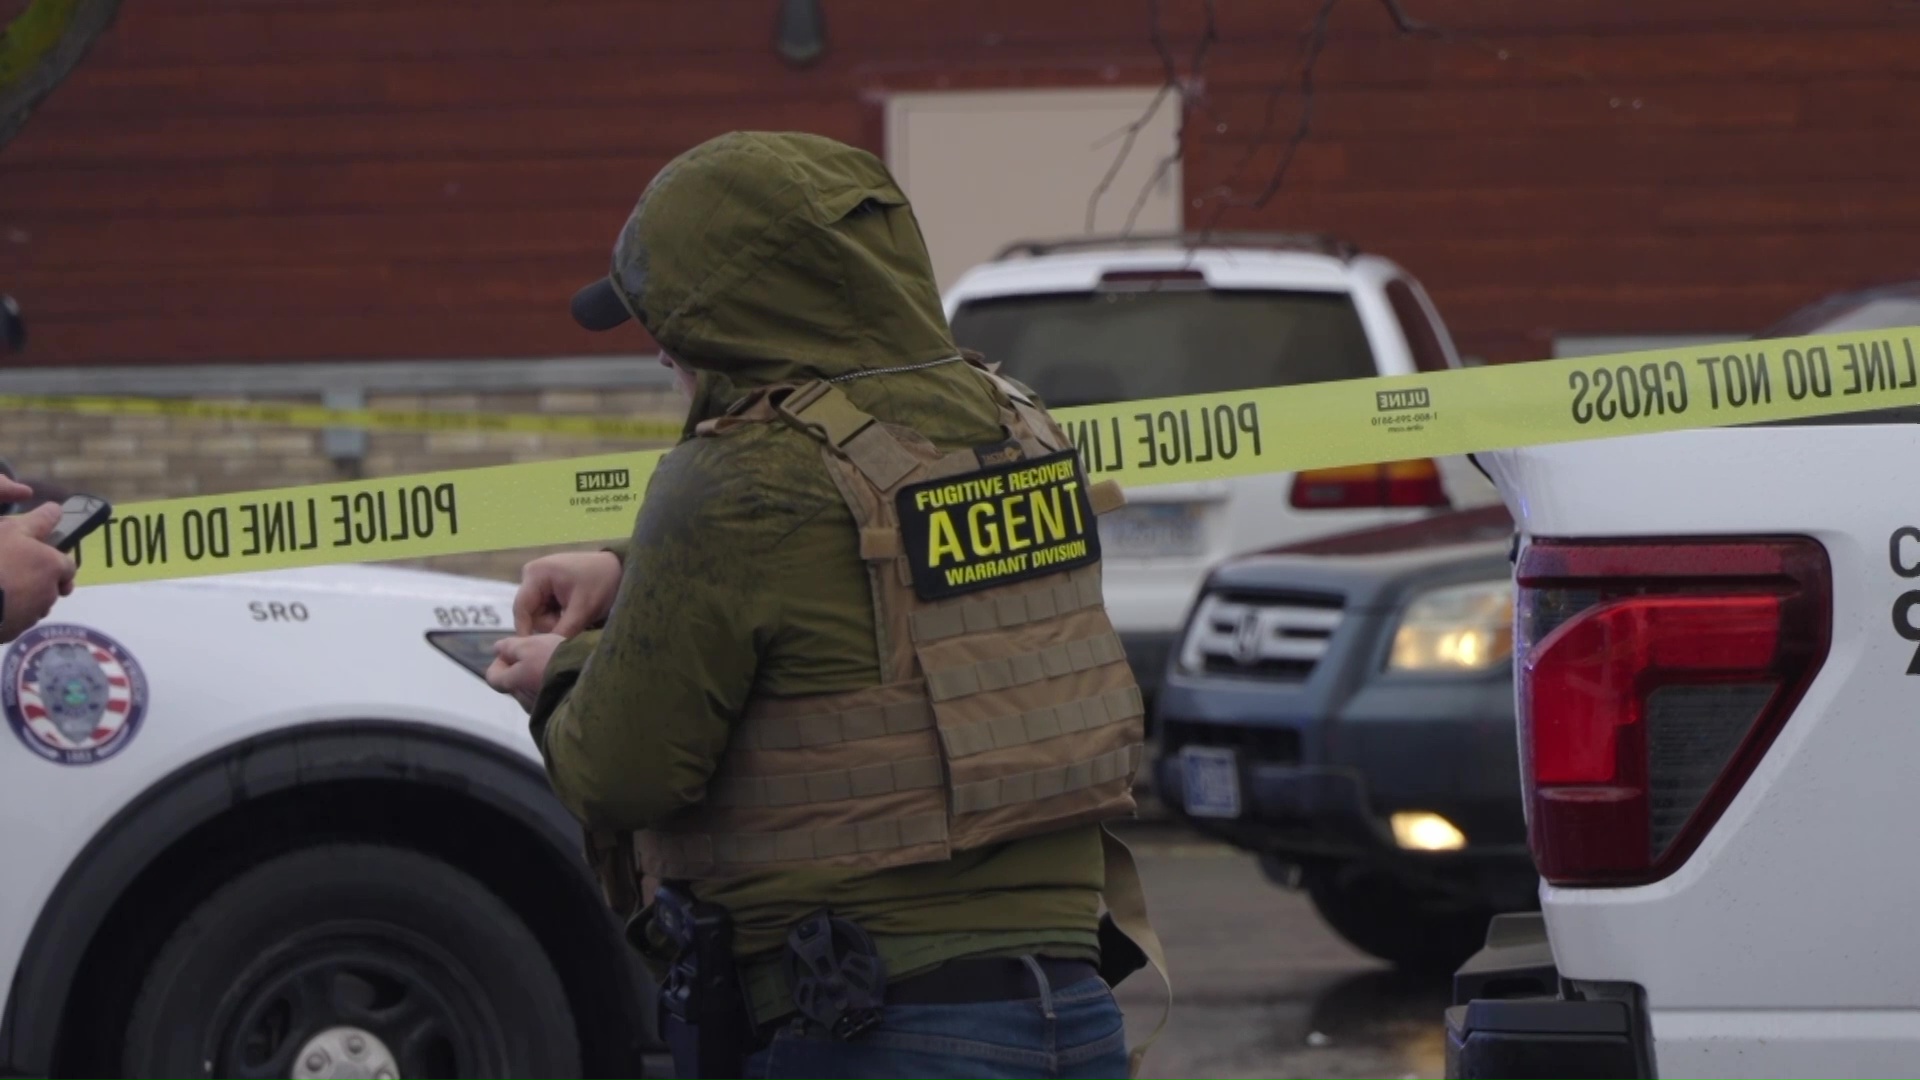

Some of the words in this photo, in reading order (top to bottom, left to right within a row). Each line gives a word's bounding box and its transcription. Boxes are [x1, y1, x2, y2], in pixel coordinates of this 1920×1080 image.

[915, 475, 1004, 511] FUGITIVE
[1008, 458, 1075, 492] RECOVERY
[928, 481, 1083, 568] AGENT
[945, 553, 1028, 586] WARRANT
[1032, 540, 1087, 568] DIVISION
[248, 601, 310, 622] SRO
[434, 605, 502, 628] 8025
